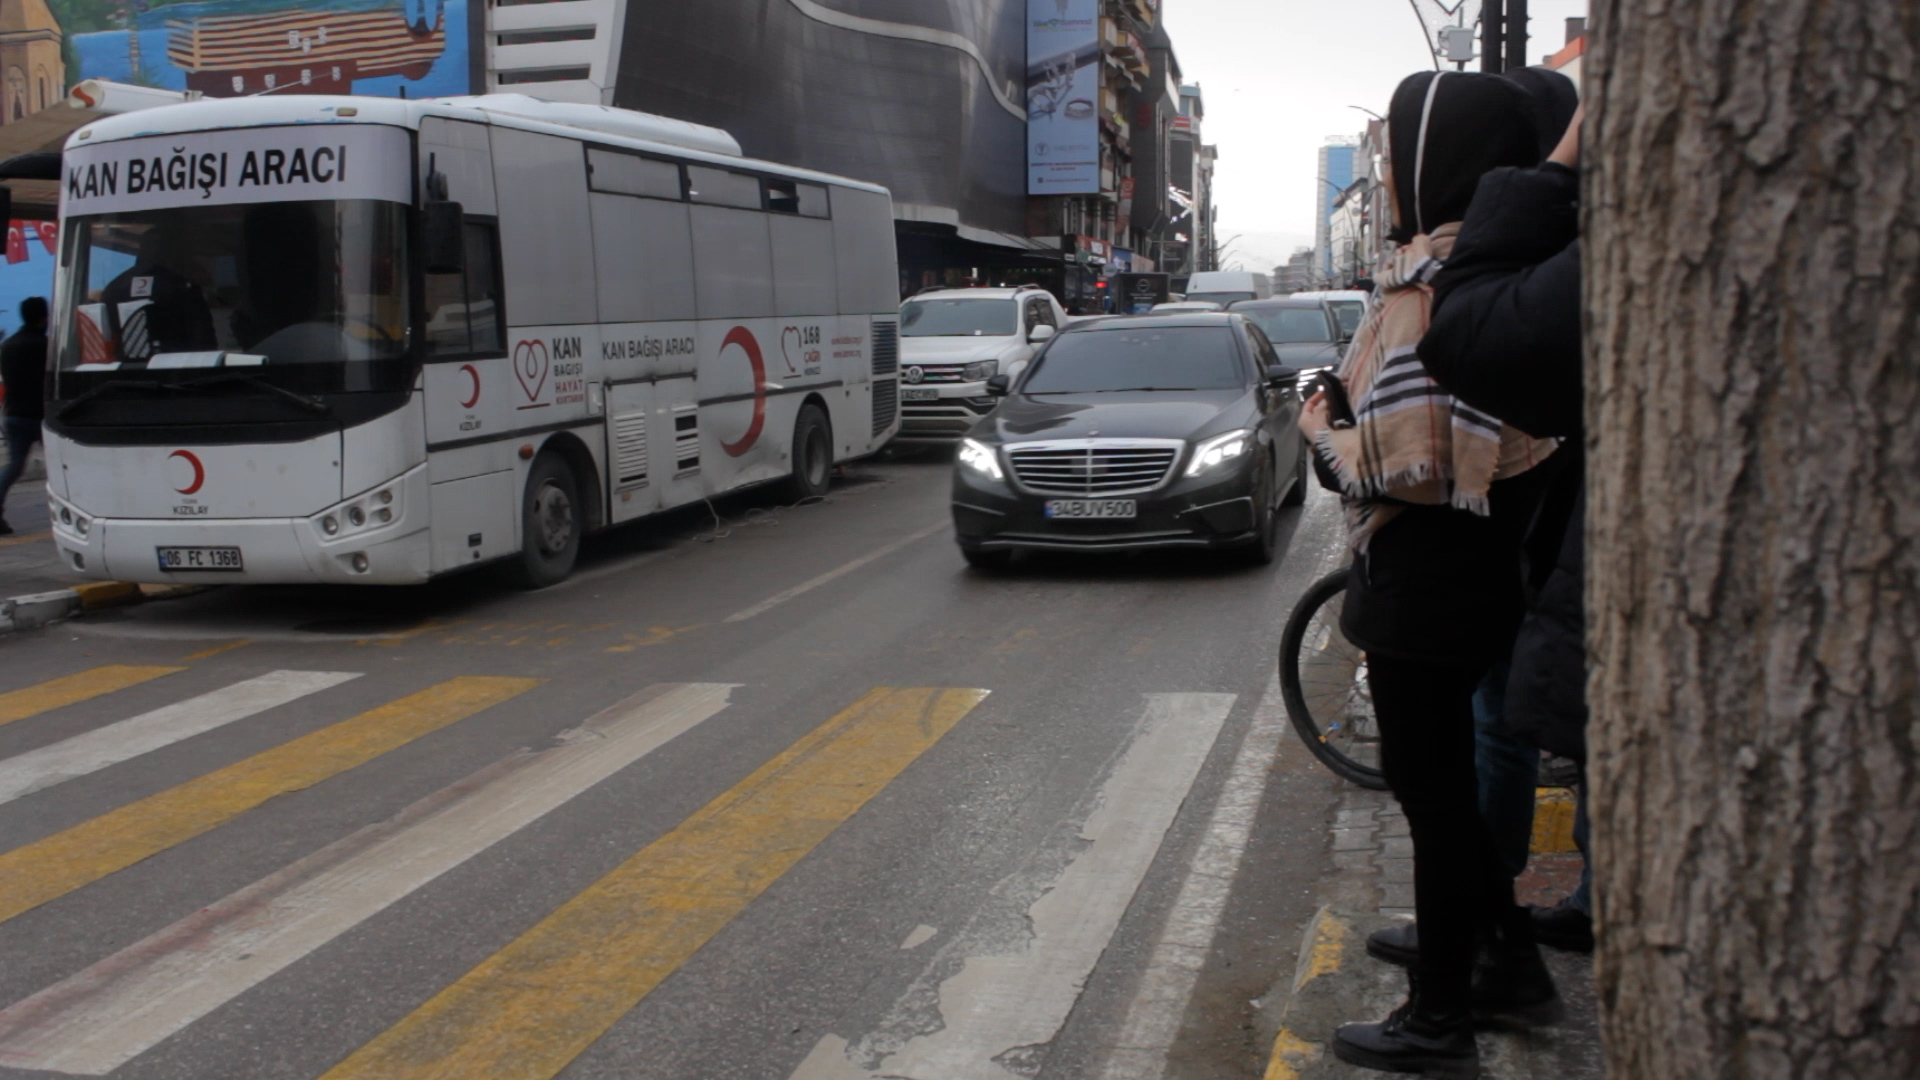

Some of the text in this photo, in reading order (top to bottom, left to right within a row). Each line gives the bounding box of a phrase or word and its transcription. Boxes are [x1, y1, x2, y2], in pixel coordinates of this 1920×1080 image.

[68, 145, 347, 200] KAN BAĞIŞI ARACI
[804, 326, 820, 344] 168
[552, 337, 582, 359] KAN
[602, 335, 695, 361] KAN BAĞIŞI ARACI
[555, 379, 583, 394] HAYAT
[166, 550, 239, 566] 06 FC 1368
